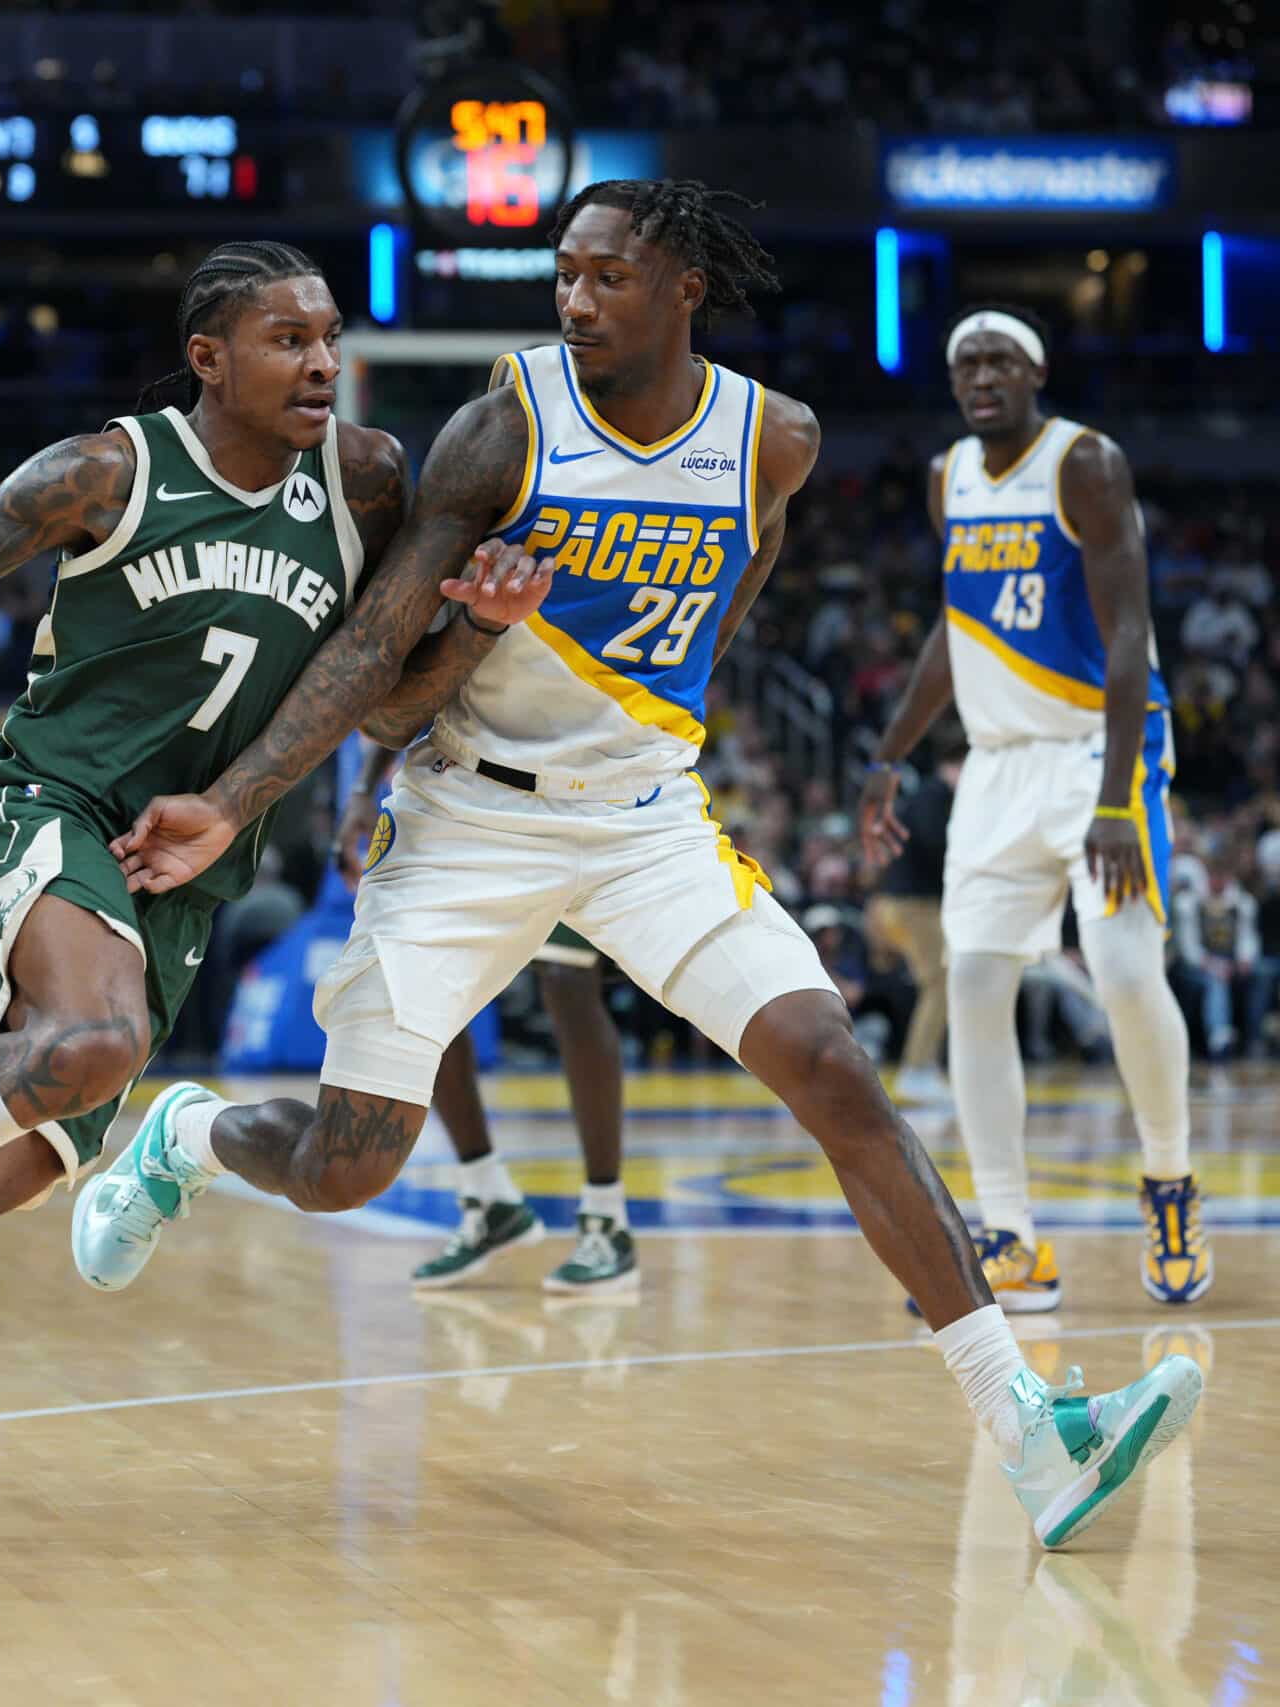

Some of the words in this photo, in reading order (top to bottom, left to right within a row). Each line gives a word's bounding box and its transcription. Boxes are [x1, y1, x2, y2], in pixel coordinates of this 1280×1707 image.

[681, 456, 718, 470] LUCAS
[719, 458, 737, 471] OIL
[525, 506, 736, 586] PACERS
[943, 520, 1045, 573] PACERS
[121, 541, 338, 632] MILWAUKEE
[601, 586, 717, 666] 29
[991, 572, 1046, 631] 43
[187, 626, 259, 732] 7
